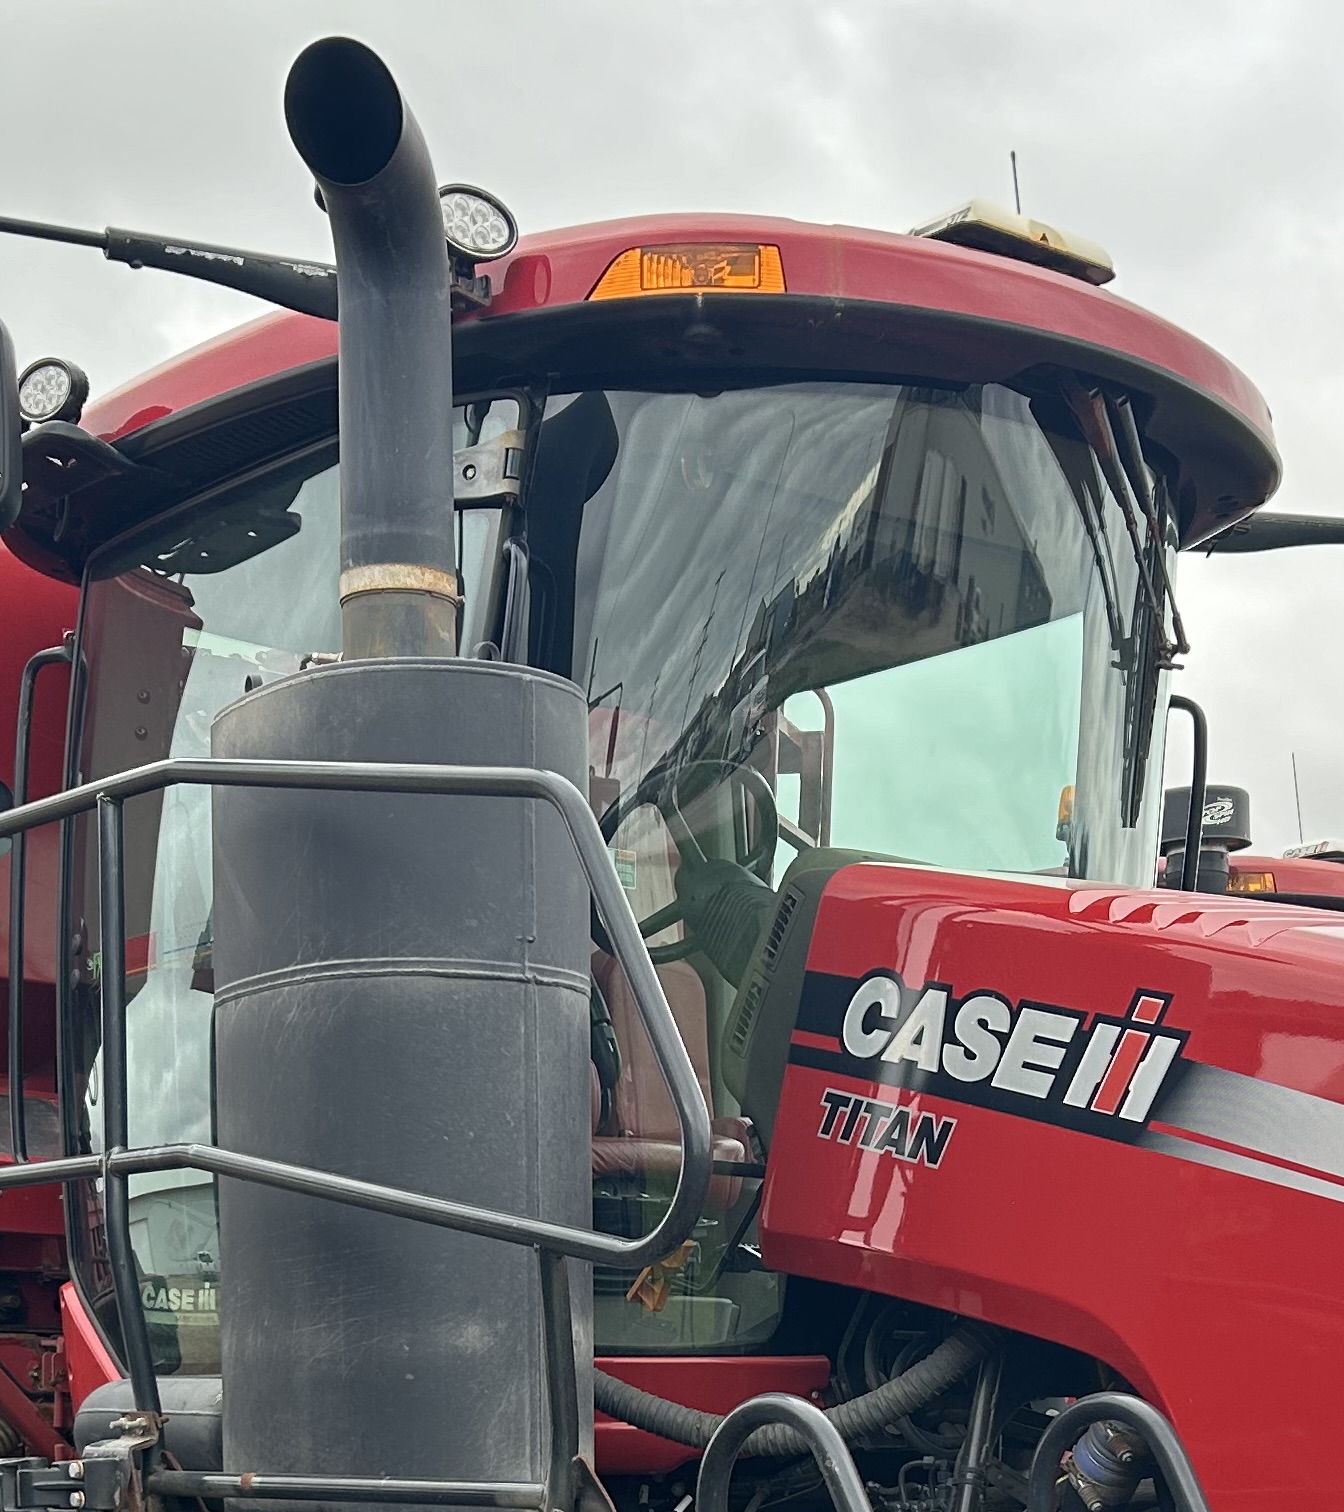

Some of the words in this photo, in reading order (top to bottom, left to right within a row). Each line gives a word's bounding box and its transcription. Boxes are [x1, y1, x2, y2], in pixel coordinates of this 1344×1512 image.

[842, 975, 1080, 1099] CASE
[817, 1087, 958, 1169] TITAN
[142, 1285, 195, 1311] CASE
